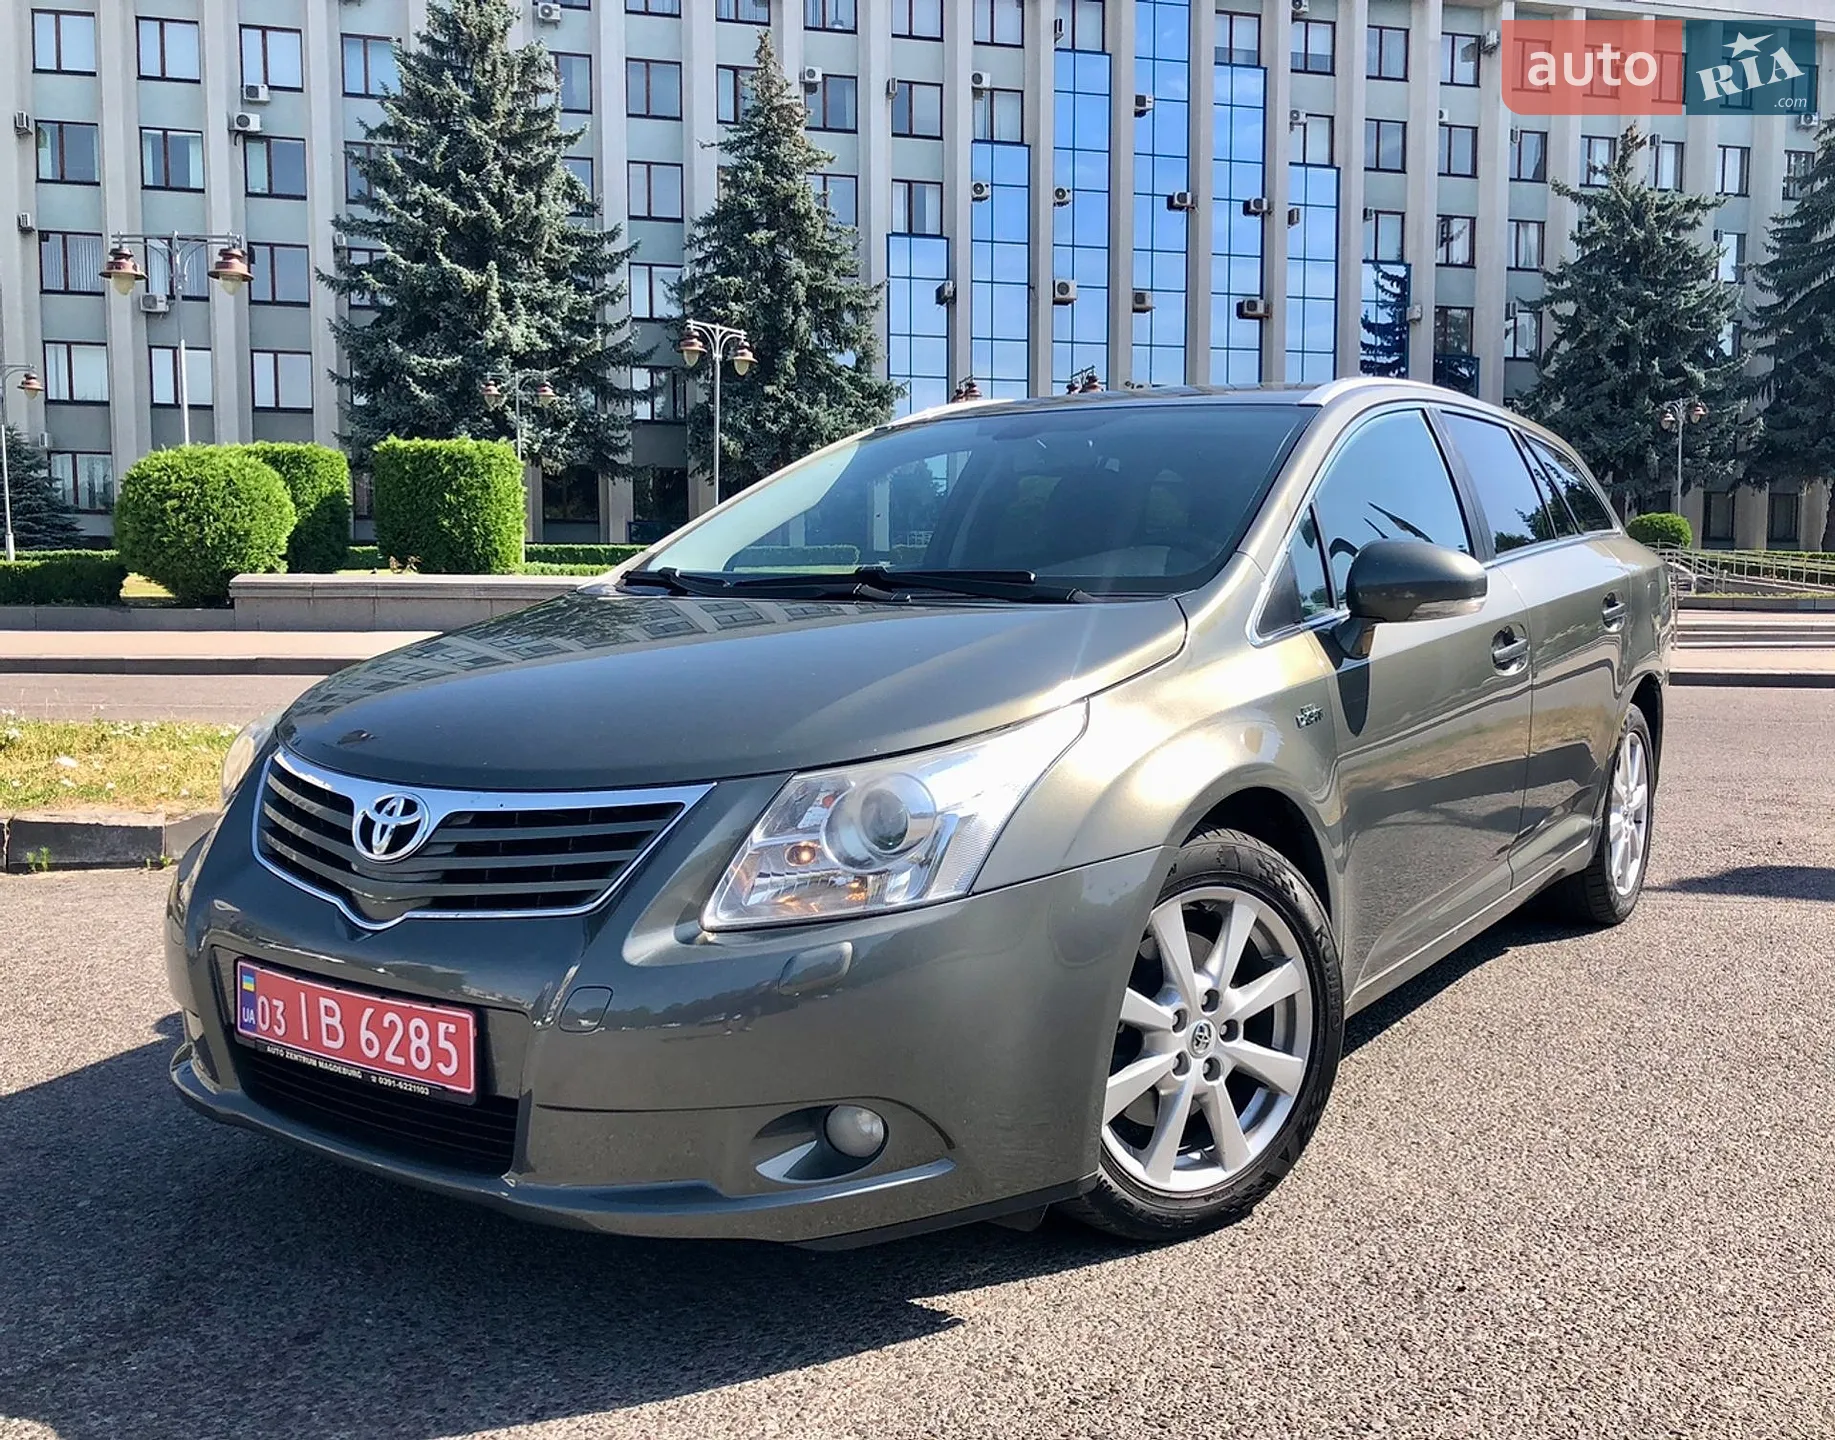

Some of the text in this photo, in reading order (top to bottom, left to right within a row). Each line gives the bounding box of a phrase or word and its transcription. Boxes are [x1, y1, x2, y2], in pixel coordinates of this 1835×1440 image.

[242, 1007, 256, 1026] UA
[257, 995, 287, 1037] 03
[359, 1007, 459, 1077] 6285
[266, 1045, 285, 1057] AUTO
[285, 1051, 318, 1067] ZENTRUM
[318, 1061, 362, 1079] MAGDEBURG
